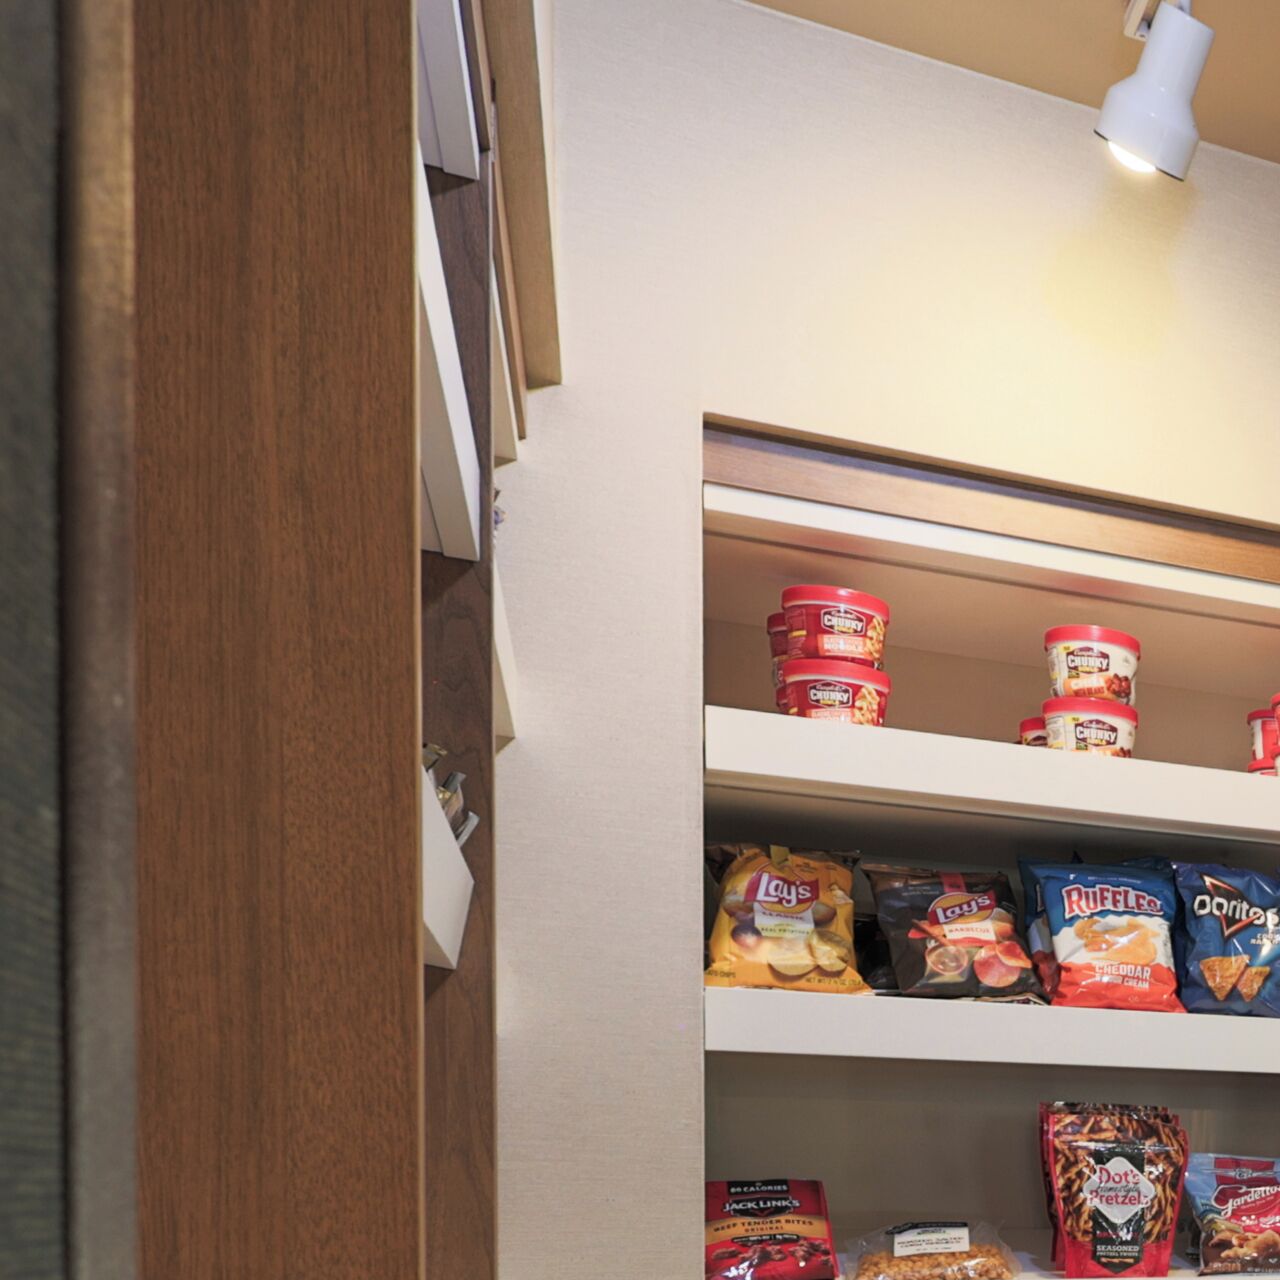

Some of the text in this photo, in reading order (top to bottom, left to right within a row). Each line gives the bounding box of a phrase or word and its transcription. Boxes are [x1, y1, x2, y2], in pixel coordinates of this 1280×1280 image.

[823, 614, 864, 631] CHUNKY
[1067, 655, 1109, 669] CHUNKY
[810, 688, 849, 703] CHUNKY
[1076, 728, 1117, 742] CHUNKY
[756, 872, 812, 908] Lay's
[936, 895, 991, 924] Lay's
[1063, 884, 1164, 919] RUFFLES
[1193, 894, 1280, 926] Doritos
[1095, 963, 1152, 980] CHEDDAR
[1123, 977, 1150, 989] CREAM
[1098, 1166, 1141, 1185] Dot's
[723, 1200, 758, 1212] JACK
[1089, 1189, 1151, 1207] Pretzels
[740, 1218, 782, 1228] TENDER
[784, 1217, 814, 1227] BITES
[1096, 1244, 1140, 1252] SEASONED
